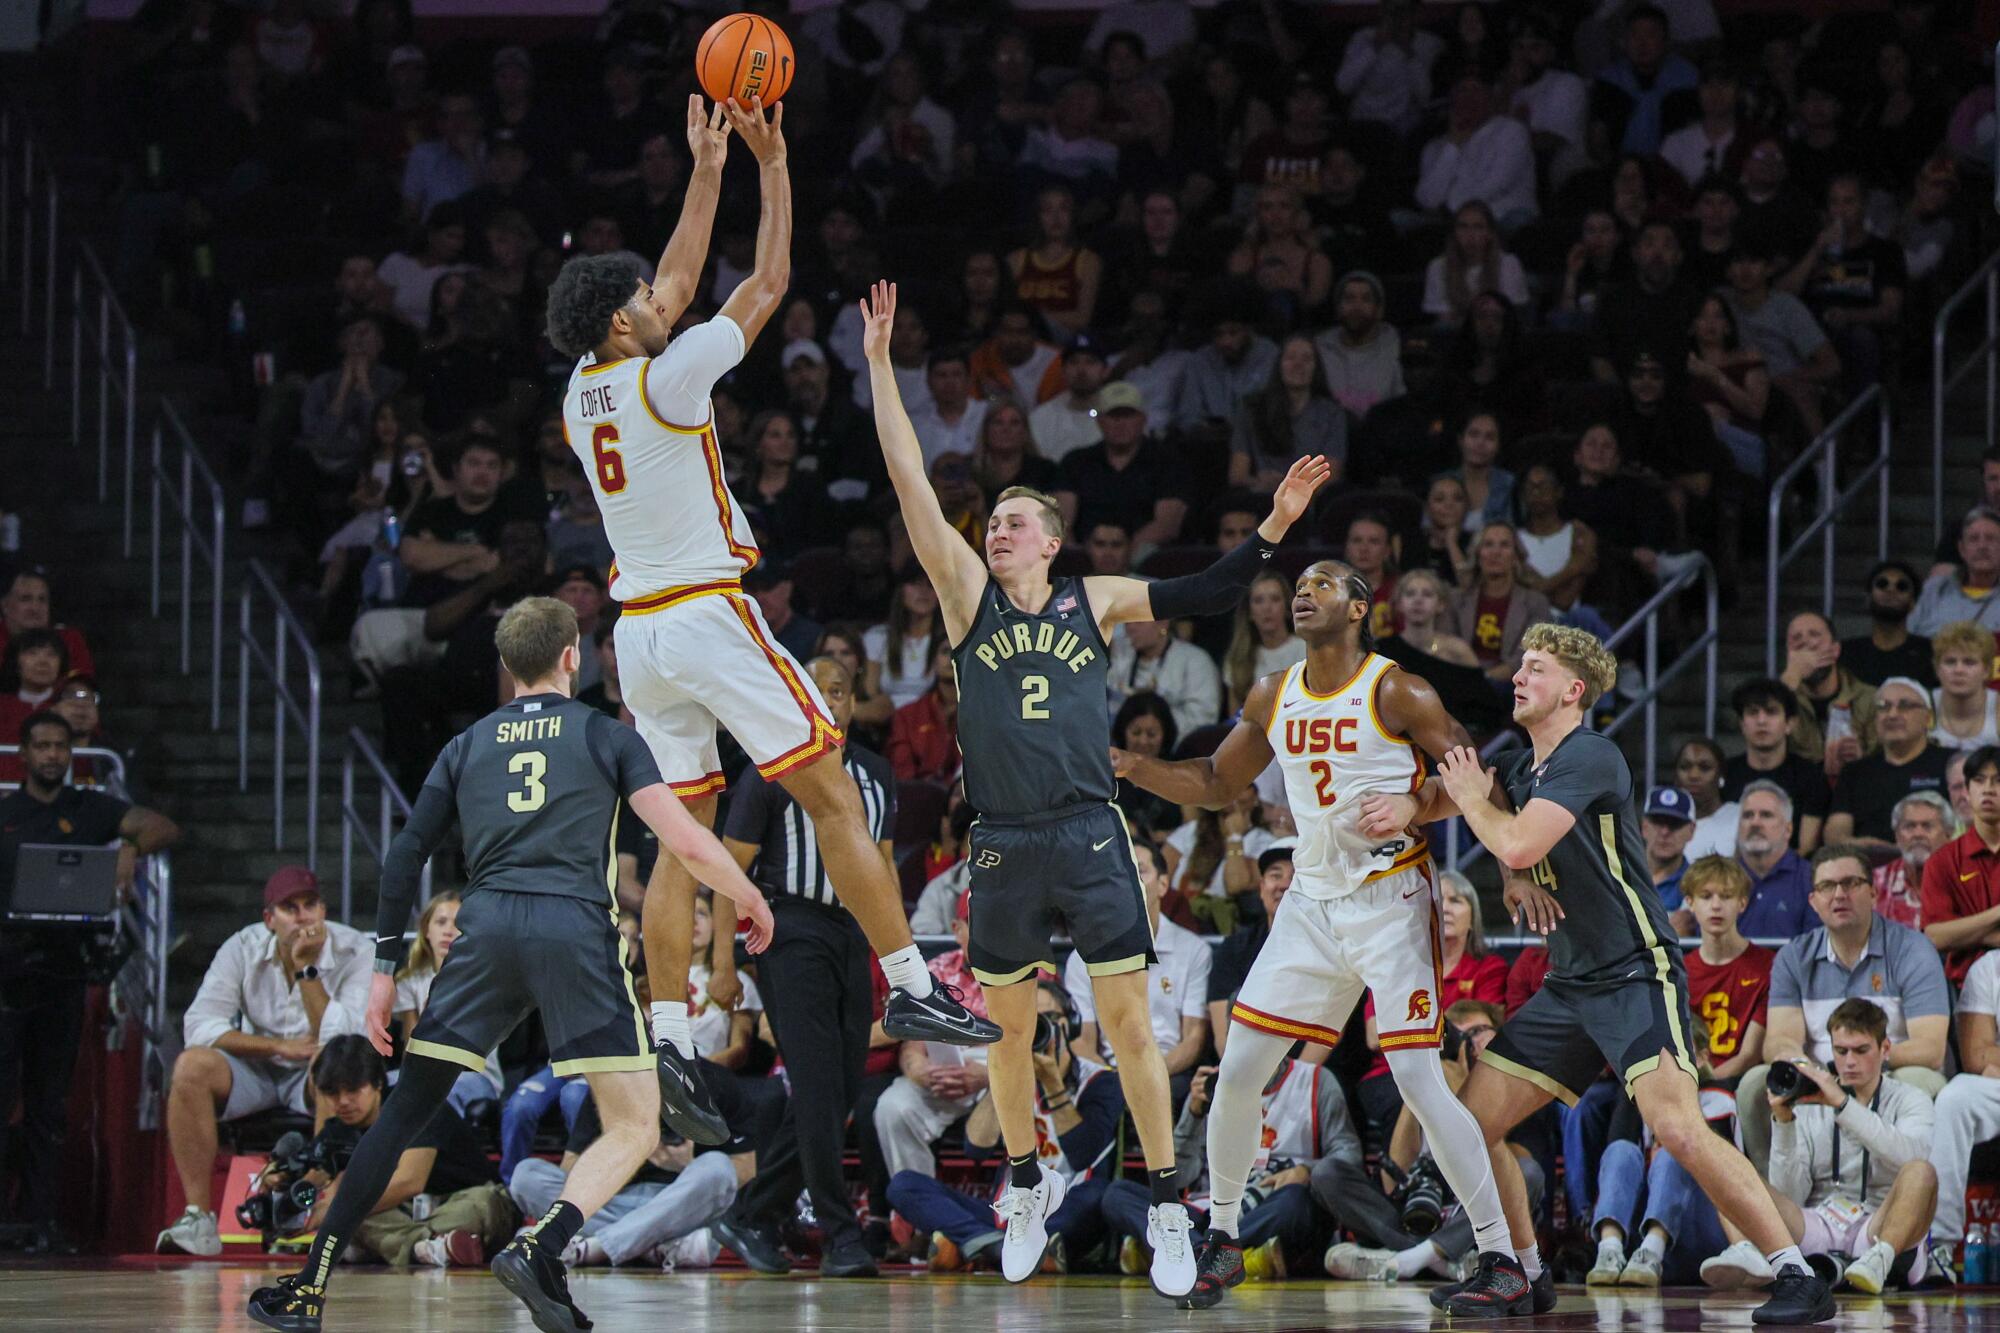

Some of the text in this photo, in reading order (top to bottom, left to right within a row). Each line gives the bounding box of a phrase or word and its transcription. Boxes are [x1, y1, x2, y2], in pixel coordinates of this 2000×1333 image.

[580, 385, 616, 417] COFIE
[592, 421, 628, 495] 6
[975, 622, 1096, 674] PURDUE
[1021, 675, 1050, 720] 2
[496, 716, 562, 743] SMITH
[1285, 718, 1360, 755] USC
[507, 750, 548, 814] 3
[1309, 760, 1338, 809] 2
[976, 849, 1001, 869] P
